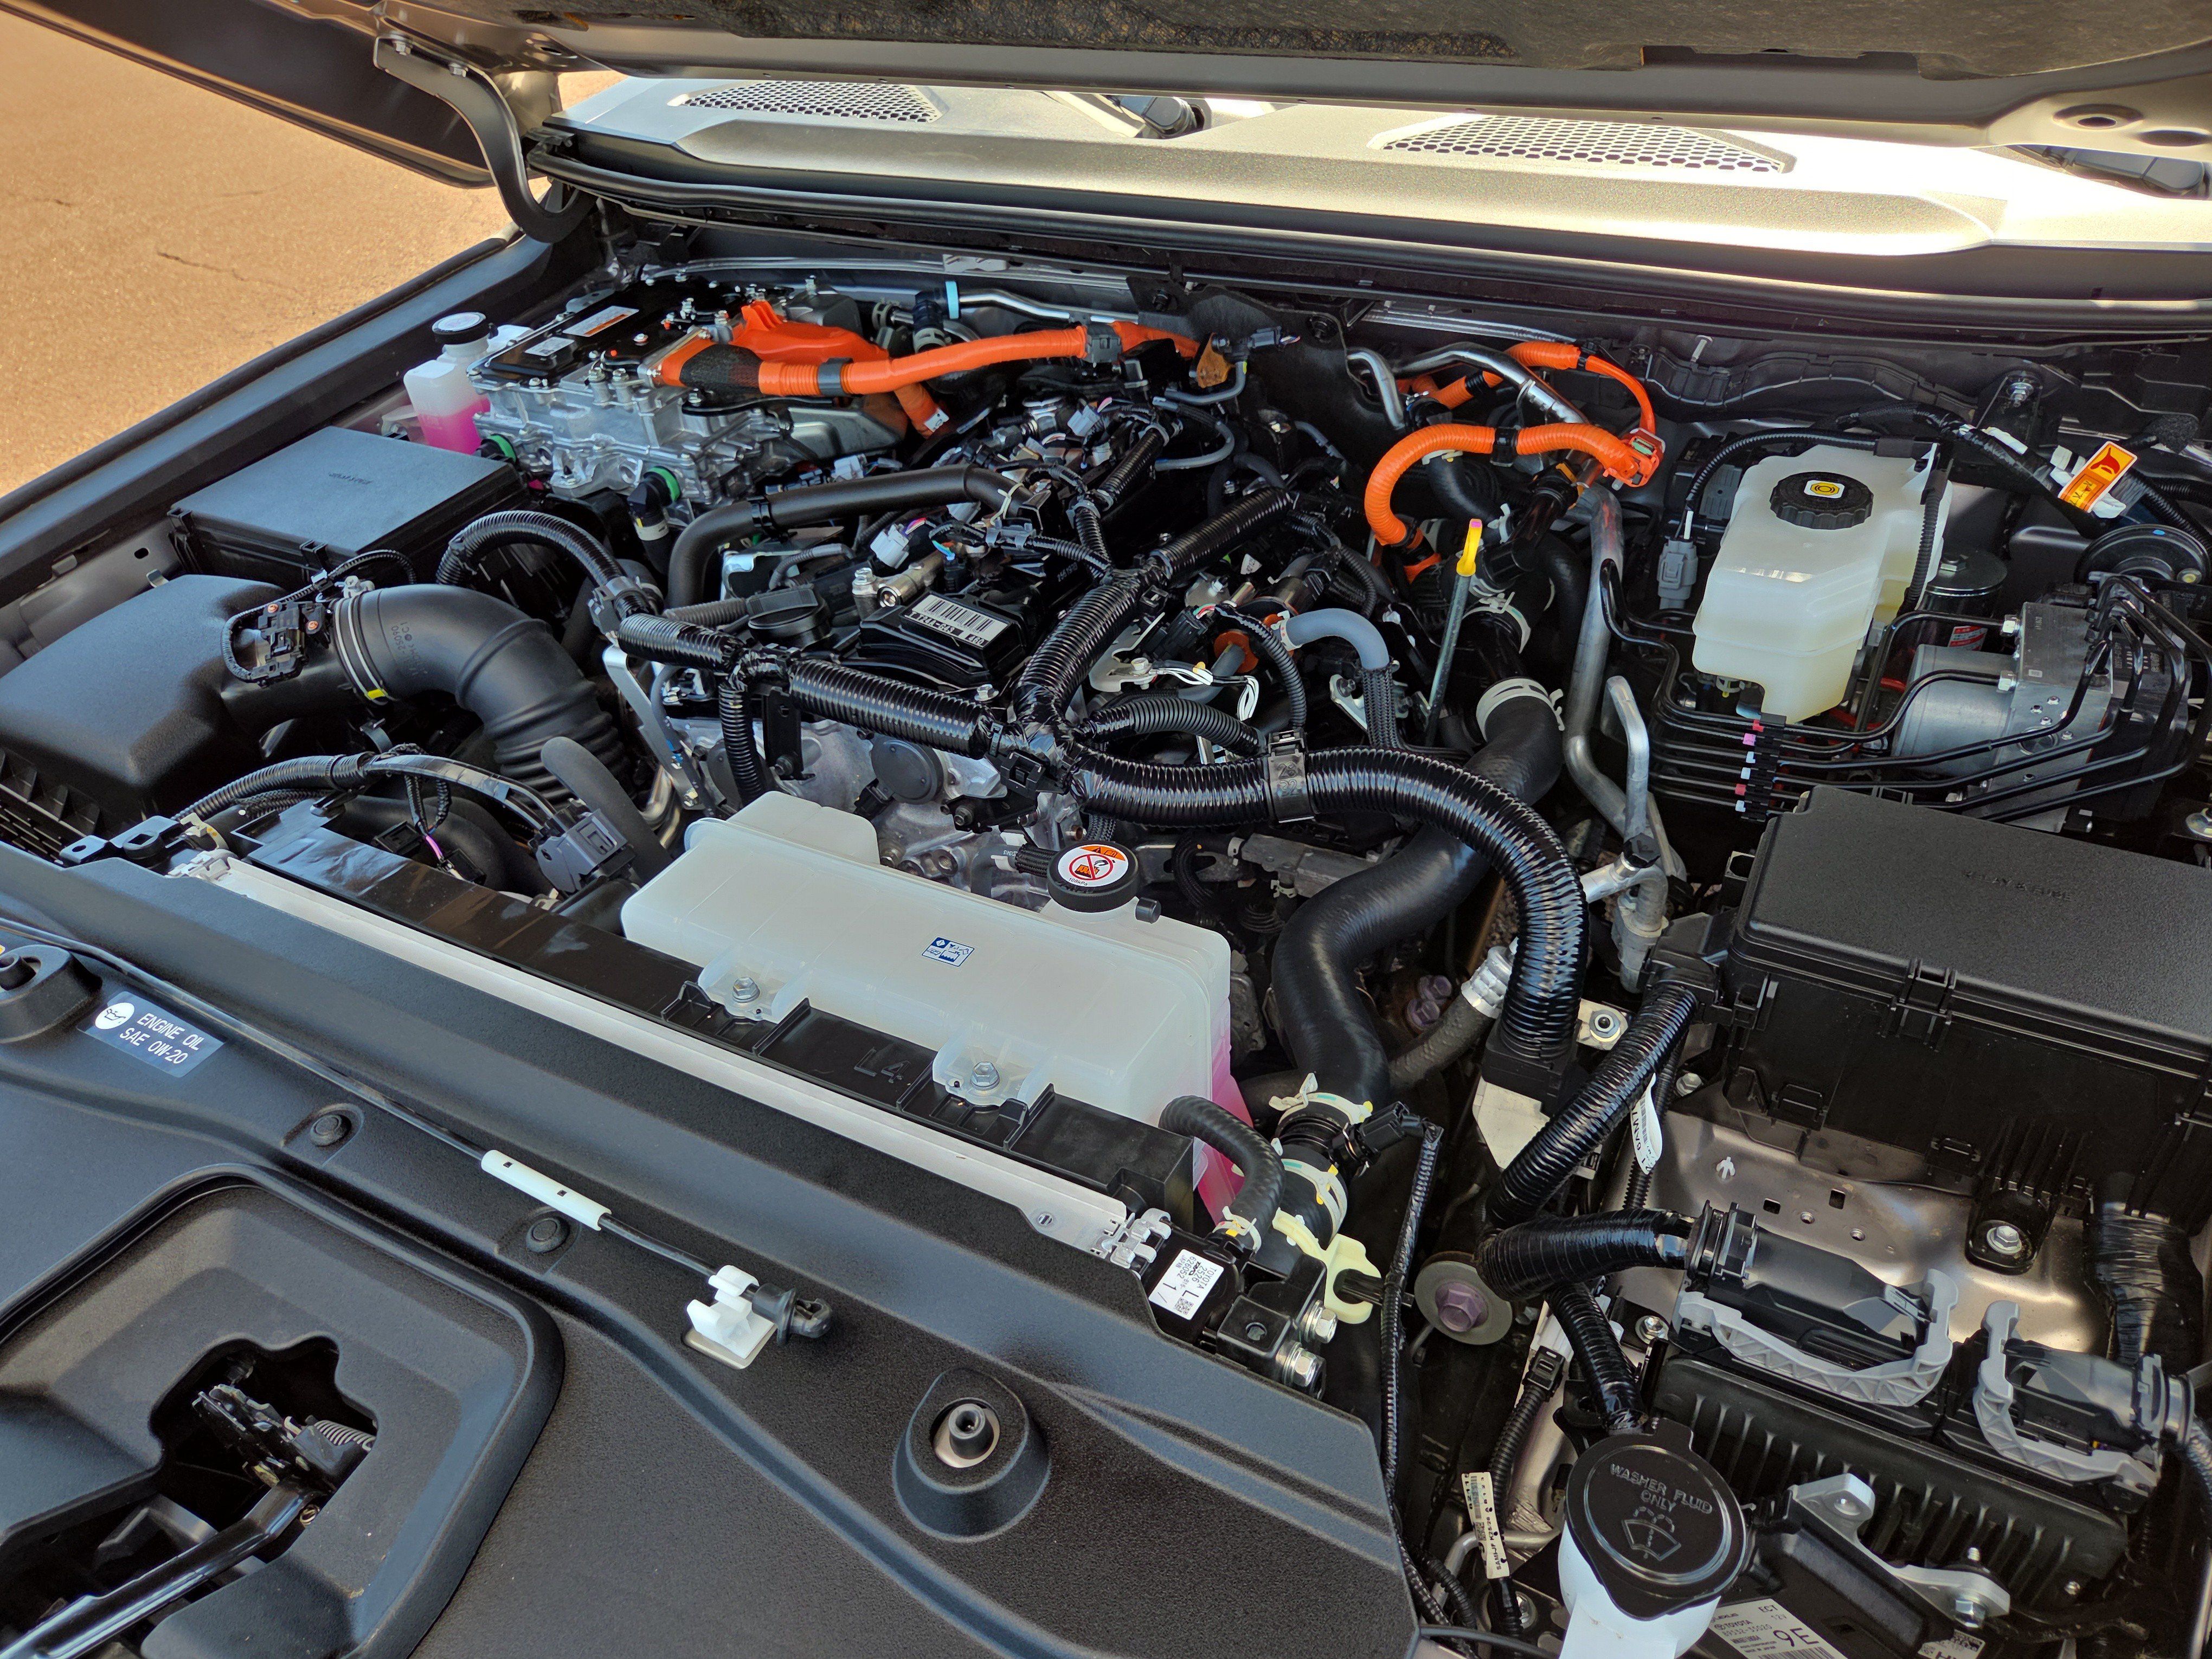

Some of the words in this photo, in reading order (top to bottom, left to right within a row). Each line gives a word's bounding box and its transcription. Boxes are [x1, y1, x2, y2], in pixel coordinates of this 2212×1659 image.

[137, 1013, 185, 1040] ENGINE
[182, 1034, 204, 1051] OIL
[119, 1027, 151, 1046] SAE
[147, 1040, 189, 1064] 0W-20
[1177, 1256, 1197, 1279] 626052
[1191, 1265, 1207, 1283] 2526
[1197, 1267, 1217, 1289] TOYOTA
[1610, 1464, 1667, 1496] WASHER
[1673, 1489, 1713, 1515] FLUID
[1640, 1489, 1676, 1513] ONLY
[1758, 1605, 1778, 1613] ECT
[1724, 1619, 1753, 1628] TOYOTA
[1773, 1628, 1819, 1648] 9E
